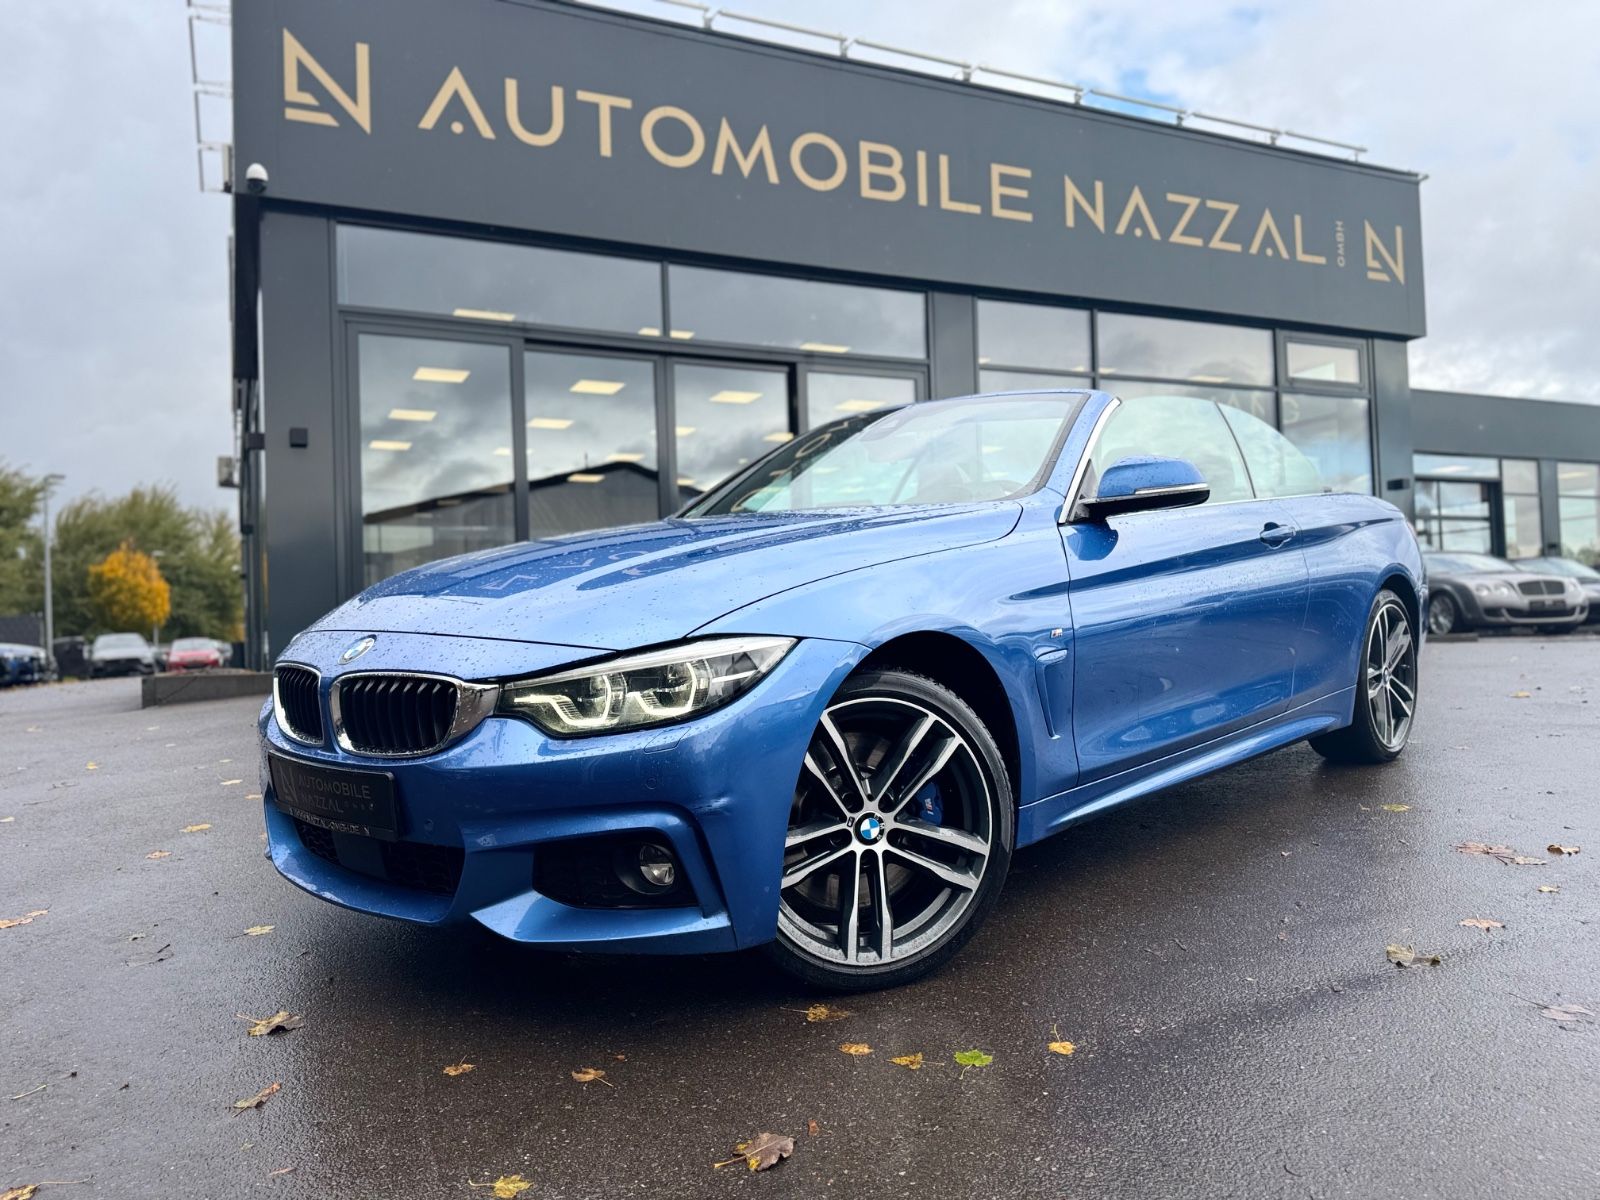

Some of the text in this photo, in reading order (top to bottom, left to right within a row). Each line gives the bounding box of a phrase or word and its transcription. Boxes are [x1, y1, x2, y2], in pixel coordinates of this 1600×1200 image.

[418, 66, 1034, 222] AUTOMOBILE
[1064, 174, 1327, 264] NAZZAL
[298, 773, 372, 800] AUTOMOBILE
